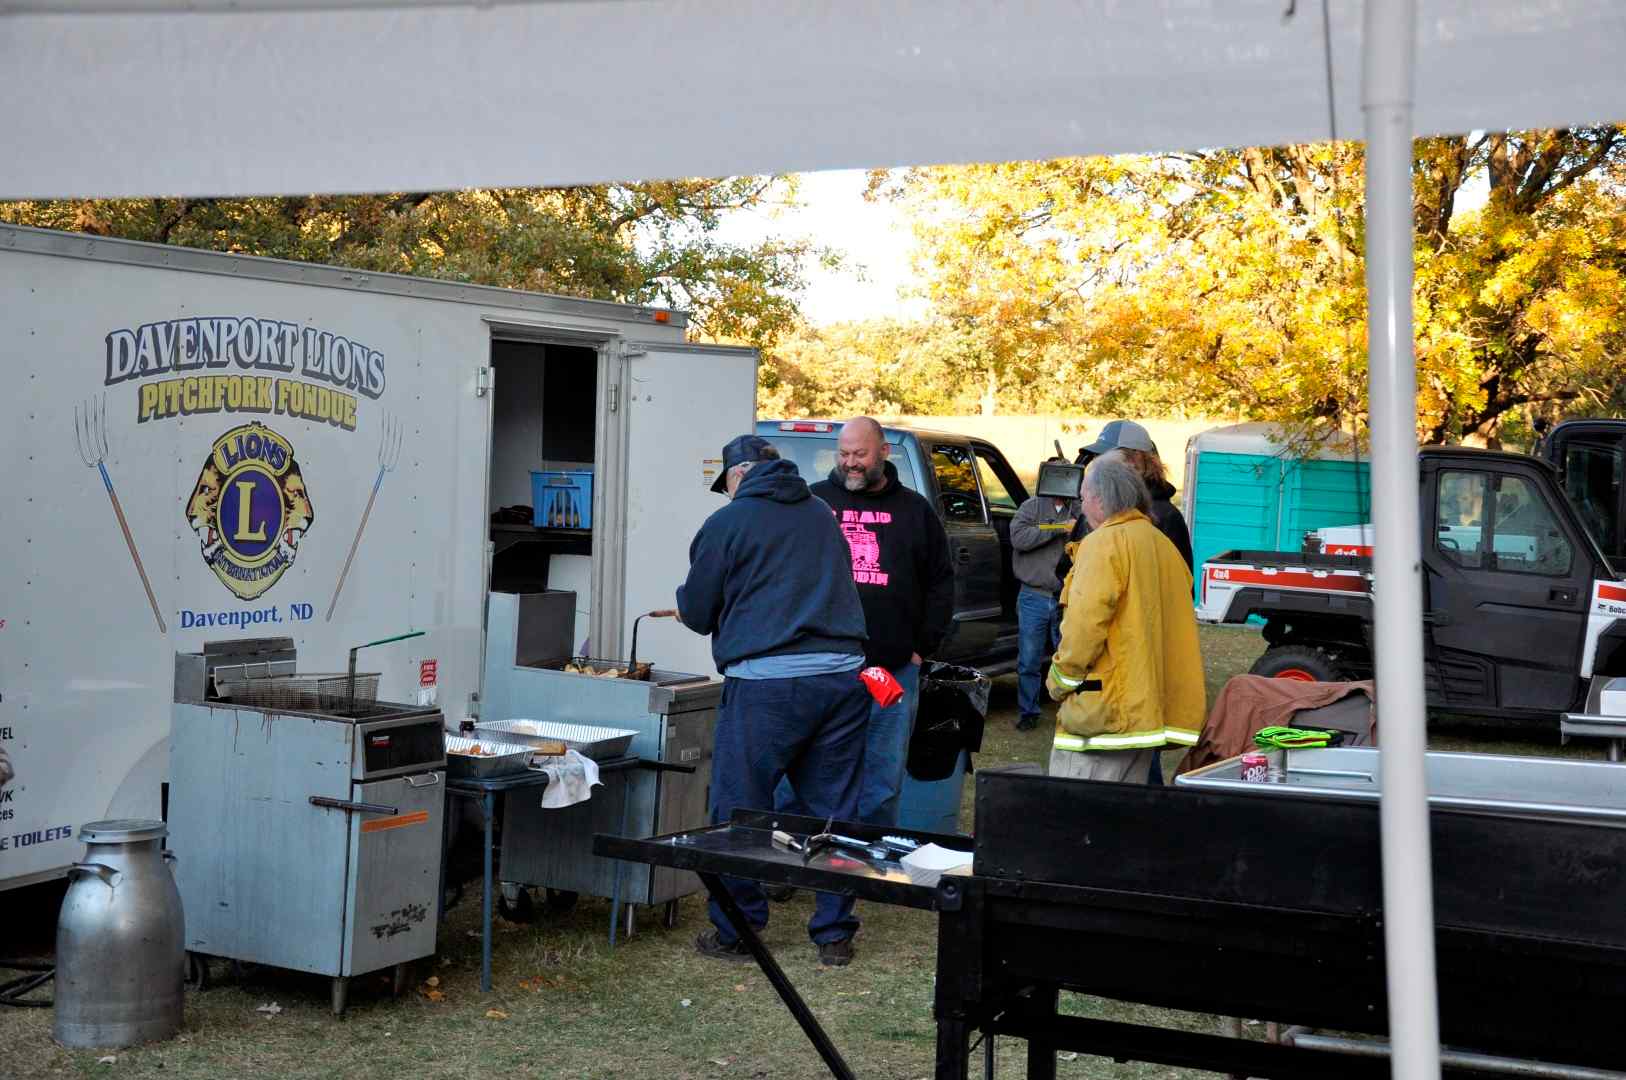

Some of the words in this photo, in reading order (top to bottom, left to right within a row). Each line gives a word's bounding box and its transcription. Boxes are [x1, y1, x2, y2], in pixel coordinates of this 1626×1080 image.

[104, 316, 299, 386] DAVENPORT
[301, 326, 385, 400] LIONS
[138, 374, 273, 424] PITCHFORK
[274, 377, 358, 432] FONDUE
[222, 432, 288, 470] LIONS
[233, 481, 267, 542] L
[180, 605, 283, 630] Davenport,
[290, 603, 314, 620] ND
[12, 825, 73, 848] TOILETS
